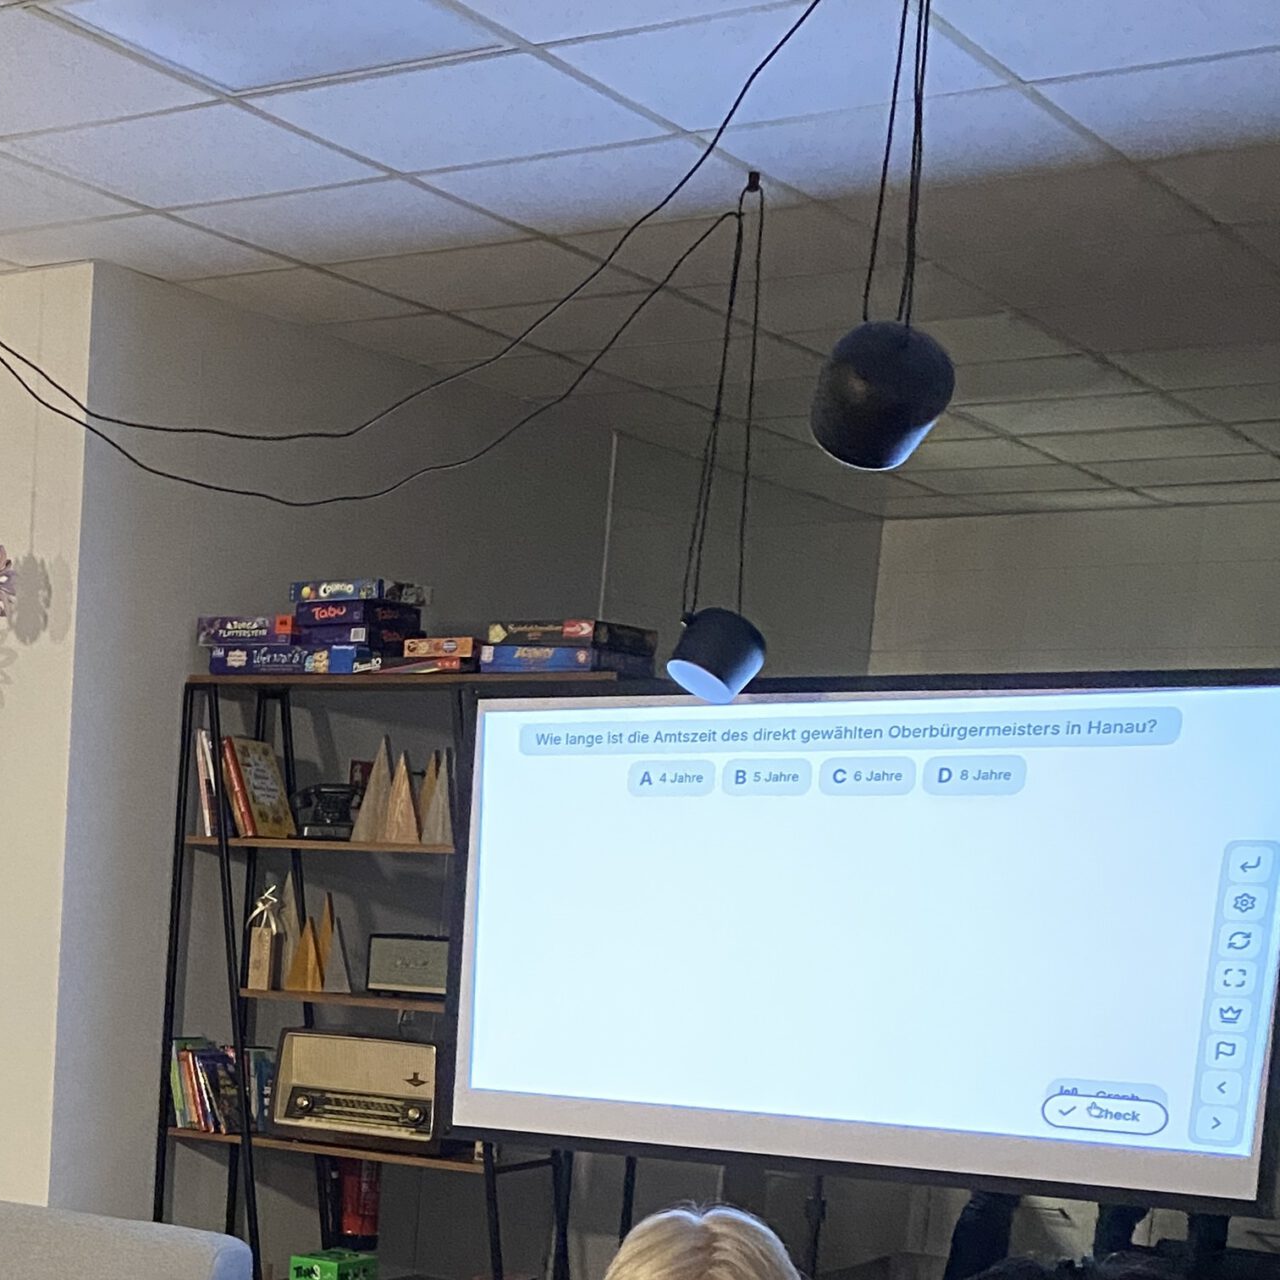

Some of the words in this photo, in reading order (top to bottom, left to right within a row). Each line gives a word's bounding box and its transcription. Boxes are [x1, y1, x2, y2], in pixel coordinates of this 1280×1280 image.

[312, 605, 346, 620] Tabu
[535, 732, 562, 746] Wie
[565, 731, 604, 748] lange
[607, 731, 623, 745] ist
[627, 730, 650, 744] die
[653, 728, 717, 744] Amtszeit
[721, 727, 748, 742] des
[753, 726, 797, 742] direkt
[800, 724, 884, 744] gewählten
[888, 720, 1061, 742] Oberbürgermeisters
[1066, 720, 1081, 736] in
[1088, 718, 1158, 736] Hanau?
[639, 771, 653, 786] A
[659, 772, 668, 784] 4
[670, 771, 704, 785] Jahre
[734, 769, 747, 785] B
[753, 771, 762, 783] 5
[764, 769, 800, 783] Jahre
[832, 768, 847, 784] C
[853, 770, 863, 782] 6
[865, 769, 903, 782] Jahre
[937, 767, 953, 784] D
[960, 769, 970, 781] 8
[972, 767, 1012, 782] Jahre
